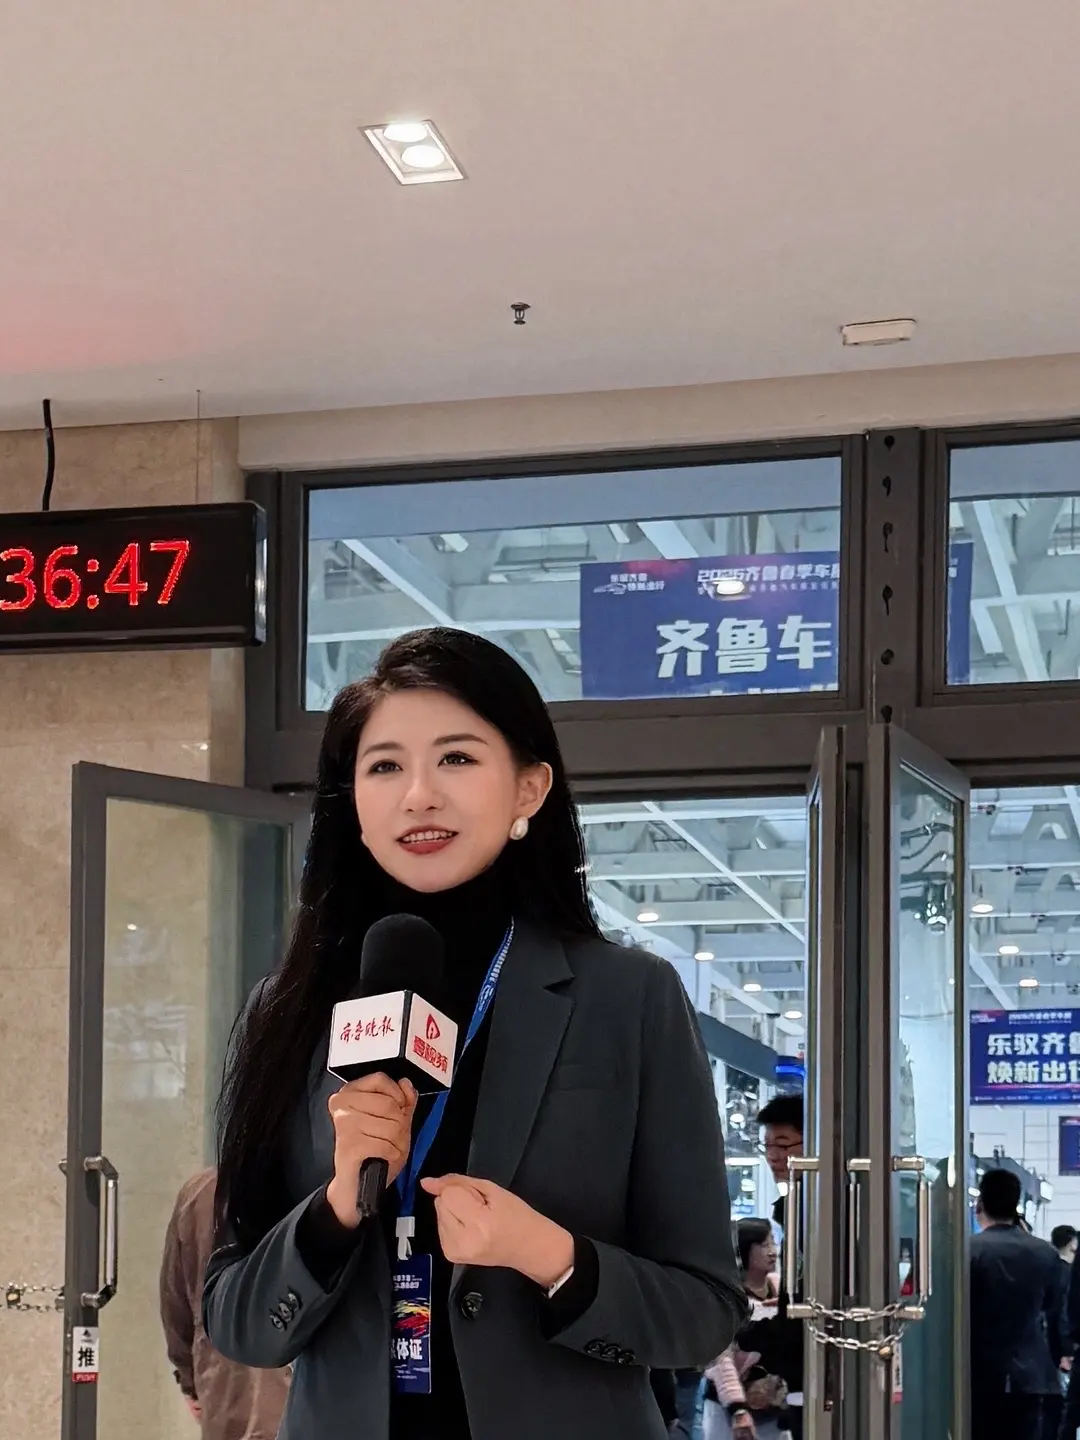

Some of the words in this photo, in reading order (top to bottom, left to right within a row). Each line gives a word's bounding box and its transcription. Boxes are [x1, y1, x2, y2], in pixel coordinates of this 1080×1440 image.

[657, 614, 832, 678] 齐鲁车
[77, 1346, 95, 1367] 推
